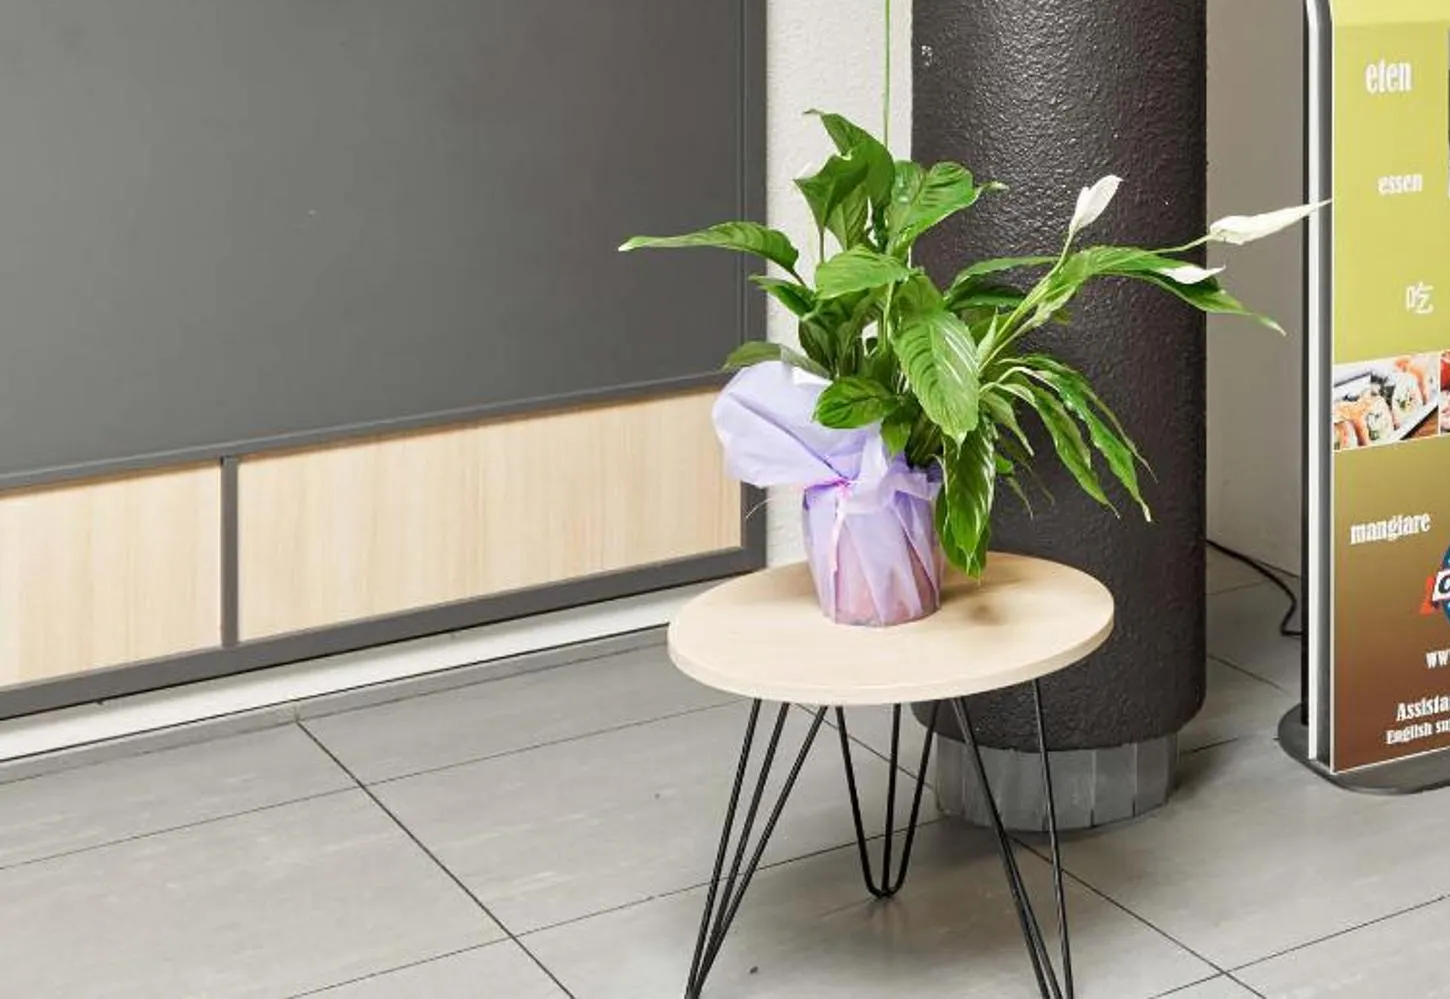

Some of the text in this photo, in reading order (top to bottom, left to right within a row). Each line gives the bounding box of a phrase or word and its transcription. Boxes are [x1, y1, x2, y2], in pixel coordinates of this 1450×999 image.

[1365, 59, 1412, 94] eten
[1378, 173, 1423, 195] essen
[1350, 512, 1432, 544] mangiare
[1386, 721, 1433, 745] English
